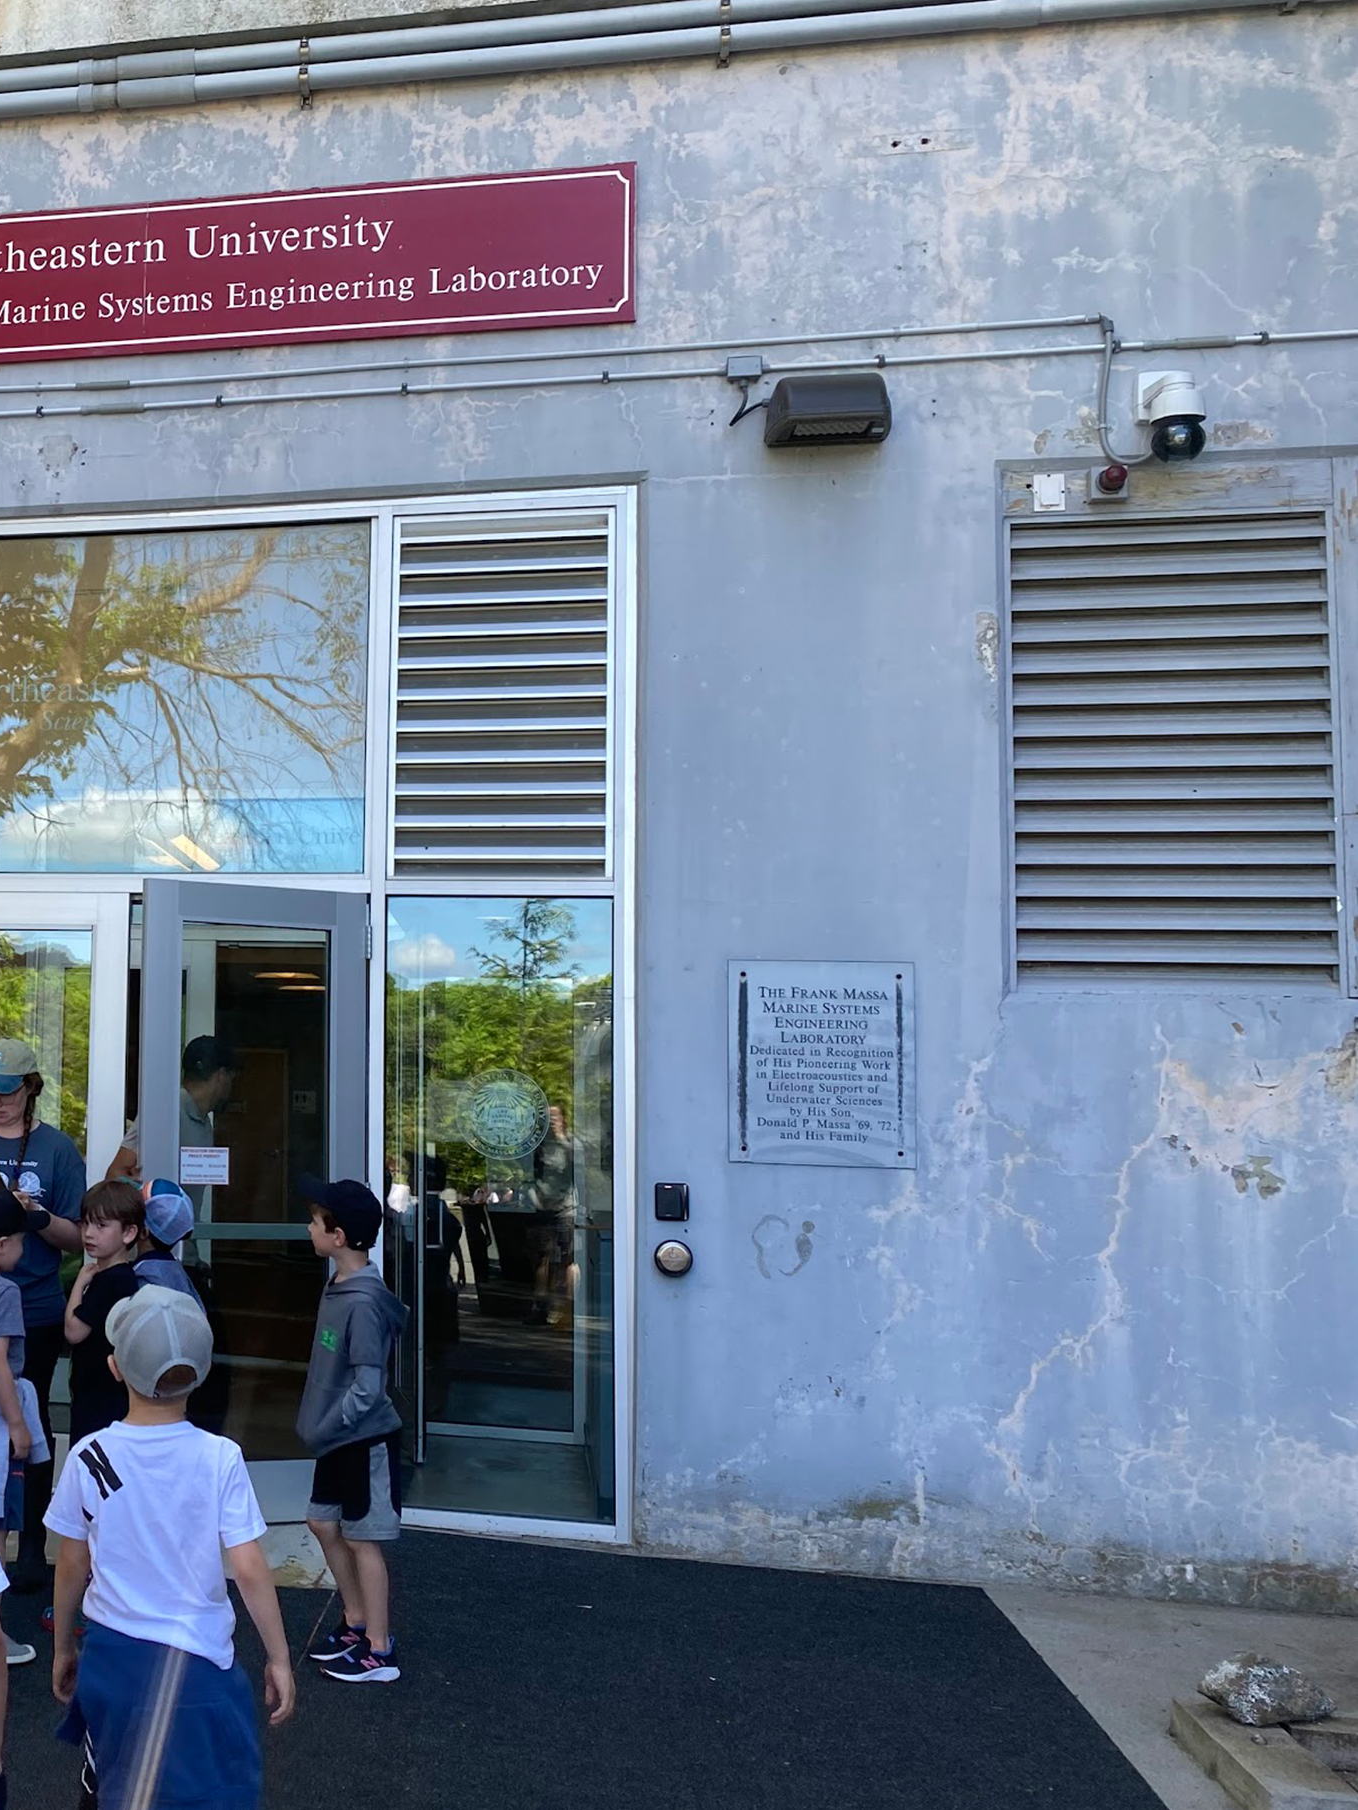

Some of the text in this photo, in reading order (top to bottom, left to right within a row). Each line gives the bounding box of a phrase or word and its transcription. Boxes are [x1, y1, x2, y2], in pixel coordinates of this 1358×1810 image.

[186, 215, 394, 259] University
[99, 292, 213, 322] Systems
[227, 272, 415, 311] Engineering
[429, 263, 605, 295] Laboratory
[758, 986, 888, 1000] THE FRANK MASSA
[762, 1002, 880, 1015] MARINE SYSTEMS
[774, 1017, 868, 1030] ENGINEERING
[780, 1032, 867, 1045] LABORATORY
[750, 1046, 894, 1059] Dedicated in Recognition
[756, 1058, 891, 1071] of His Pioneering Work
[756, 1070, 888, 1082] in Electroacoustics and
[768, 1082, 880, 1095] Lifelong Support of
[766, 1094, 883, 1106] Underwater Sciences
[790, 1107, 802, 1117] by
[807, 1107, 826, 1117] His
[757, 1117, 797, 1128] Donald
[802, 1119, 812, 1129] P.
[817, 1120, 850, 1130] Massa
[780, 1131, 869, 1144] and His Family
